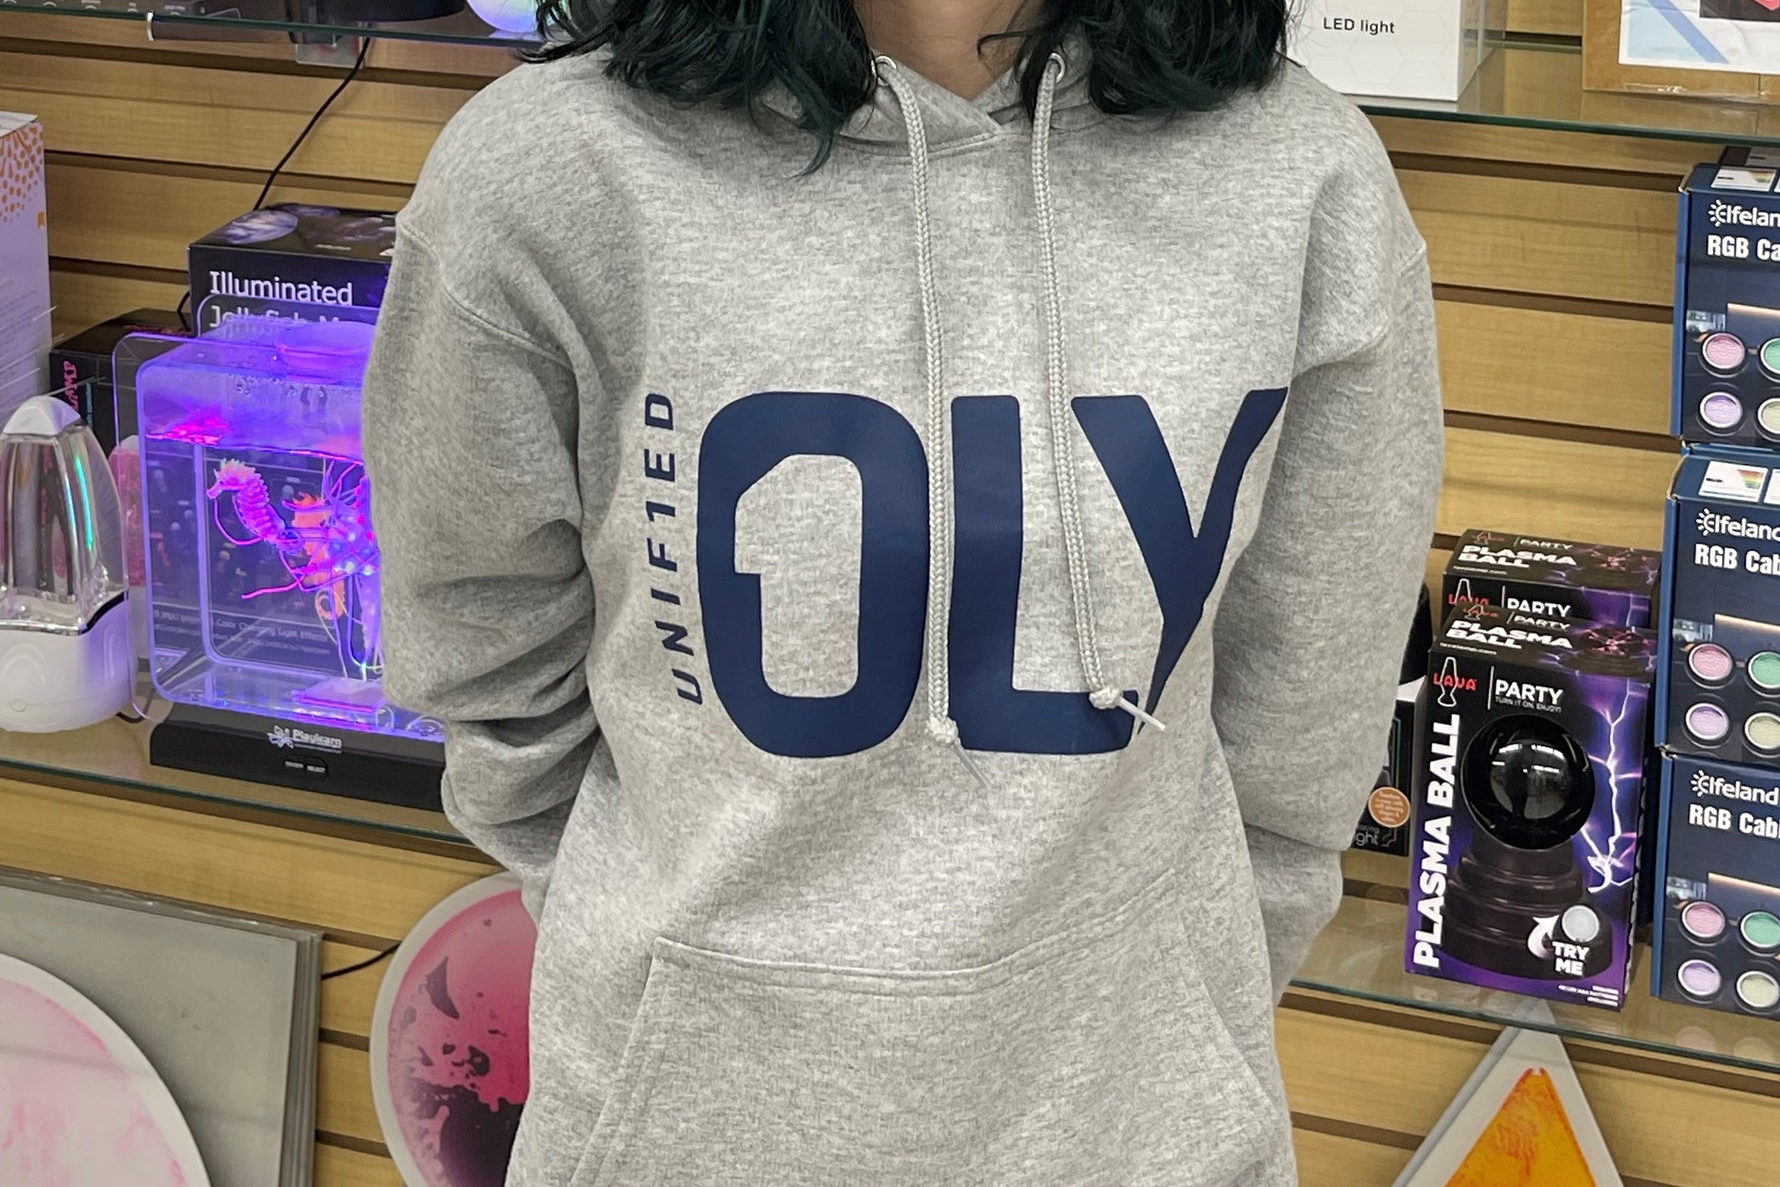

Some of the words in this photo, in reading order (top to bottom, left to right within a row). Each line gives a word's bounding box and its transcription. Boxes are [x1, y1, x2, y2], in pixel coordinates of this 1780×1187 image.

[1323, 18, 1355, 31] LED
[1360, 19, 1395, 35] light
[1707, 235, 1749, 259] RGB
[209, 271, 353, 305] Illuminated
[1458, 553, 1529, 568] BALL
[1462, 545, 1577, 566] PLASMA
[1695, 544, 1738, 570] RGB
[697, 387, 1289, 758] OLY
[1507, 598, 1571, 618] PARTY
[1446, 628, 1522, 649] BALL
[1451, 620, 1573, 649] PLASMA
[1495, 679, 1564, 705] PARTY
[1426, 714, 1460, 807] BALL
[1689, 803, 1732, 830] RGB
[1413, 815, 1453, 968] PLASMA
[1552, 941, 1590, 961] TRY
[1555, 957, 1584, 976] ME
